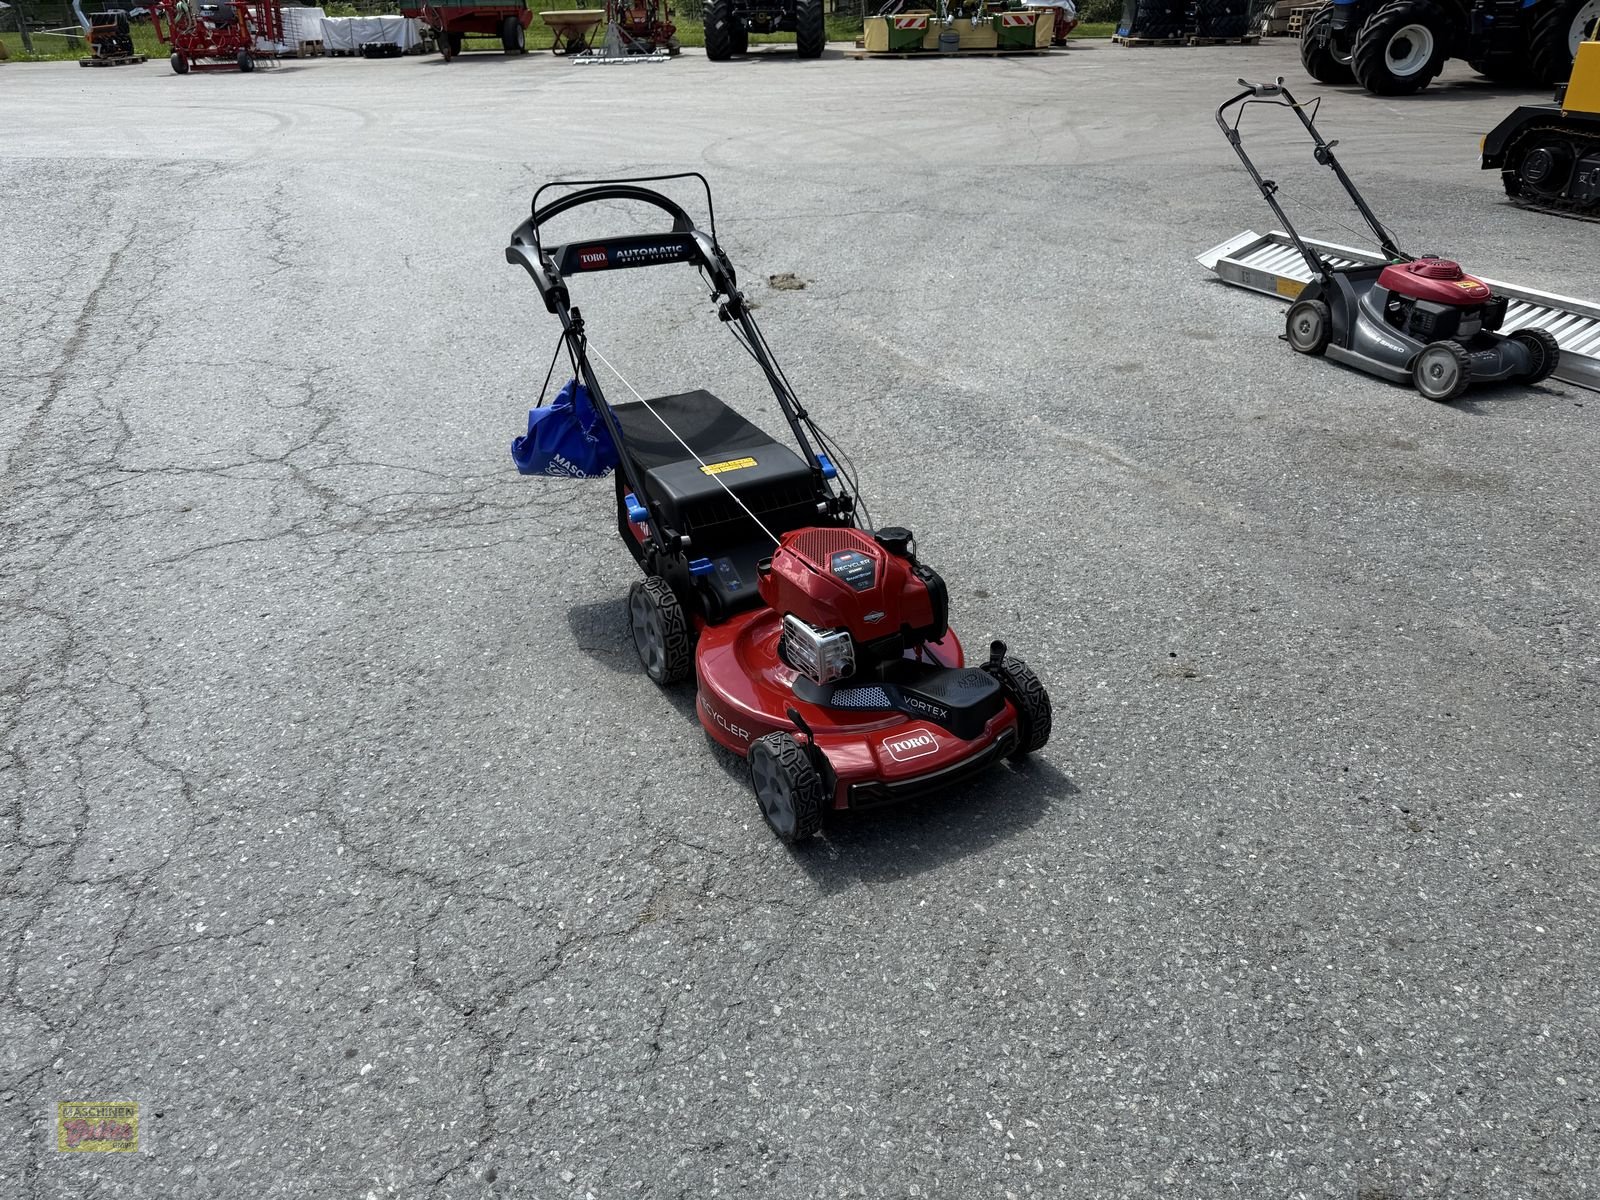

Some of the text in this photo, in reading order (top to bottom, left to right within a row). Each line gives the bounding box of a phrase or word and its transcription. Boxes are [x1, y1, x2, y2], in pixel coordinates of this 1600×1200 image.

[581, 253, 606, 263] TORO
[616, 245, 683, 258] AUTOMATIC
[834, 559, 870, 573] RECYCLER
[903, 695, 948, 719] VORTEX
[890, 735, 933, 753] TORO
